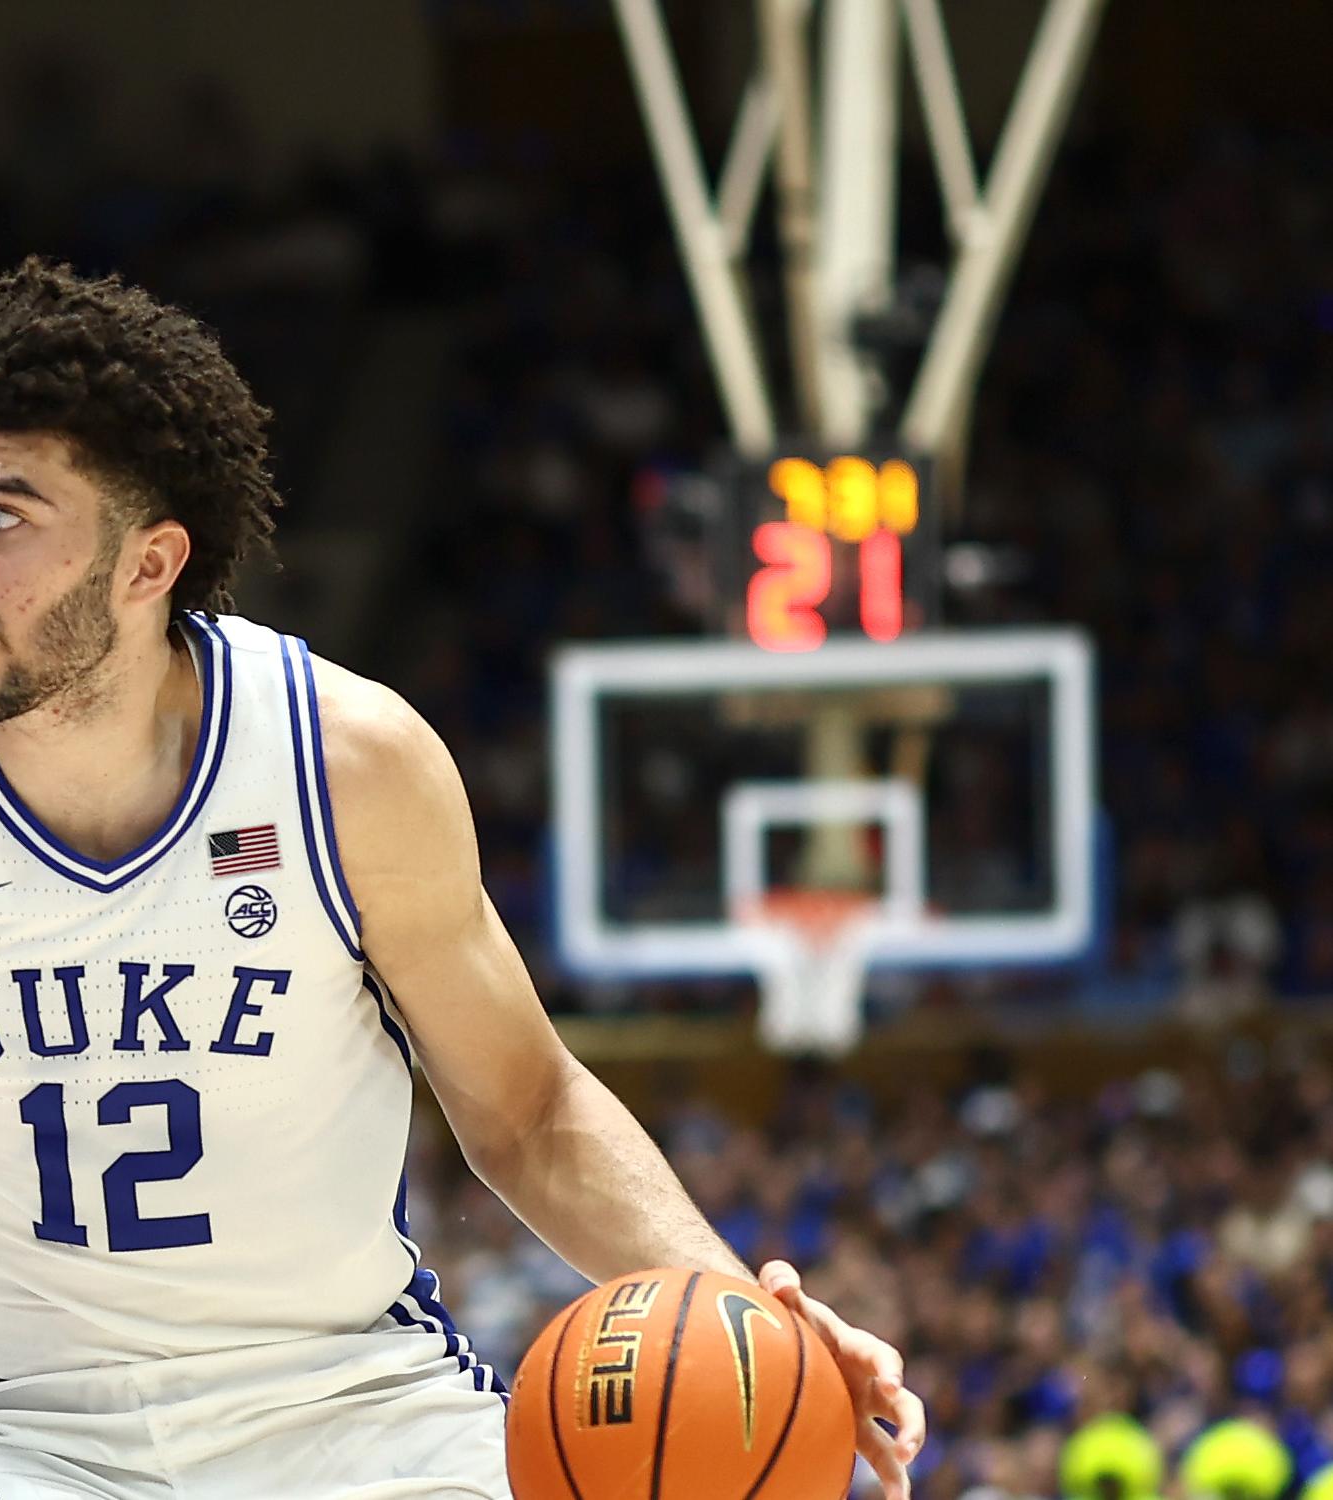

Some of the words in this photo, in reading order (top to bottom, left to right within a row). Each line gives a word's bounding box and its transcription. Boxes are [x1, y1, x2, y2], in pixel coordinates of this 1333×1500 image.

[747, 521, 903, 653] 21
[233, 900, 273, 916] ACC
[18, 1078, 213, 1253] 12
[588, 1281, 662, 1428] ELITE
